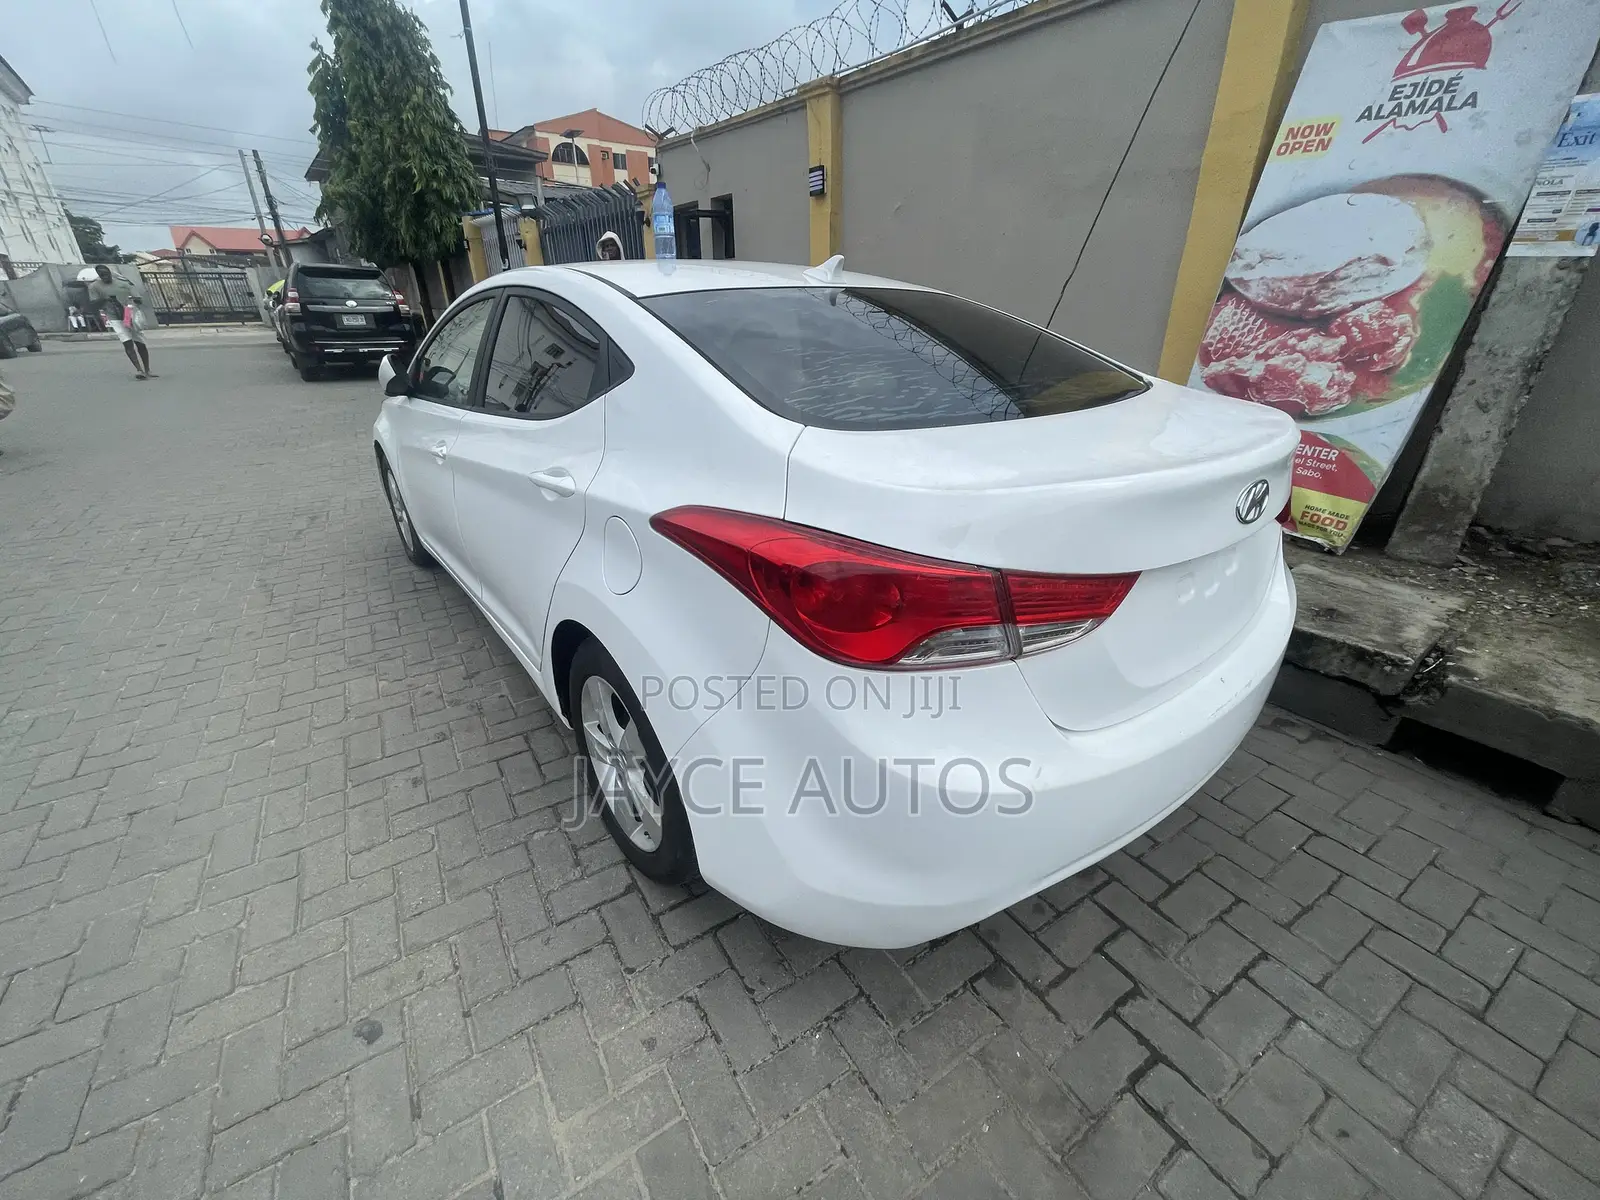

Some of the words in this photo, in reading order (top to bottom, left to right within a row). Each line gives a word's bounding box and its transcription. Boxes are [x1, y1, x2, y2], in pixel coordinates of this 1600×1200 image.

[1355, 91, 1478, 123] ALAMALA
[1284, 120, 1336, 141] NOW
[1557, 131, 1596, 148] Exit
[1276, 136, 1333, 156] OPEN
[1295, 443, 1339, 461] ENTER
[1296, 466, 1323, 479] Sabo,
[1306, 459, 1338, 472] Street,
[1300, 510, 1348, 531] FOOD
[1305, 504, 1327, 513] HOME
[1328, 510, 1350, 520] MADE
